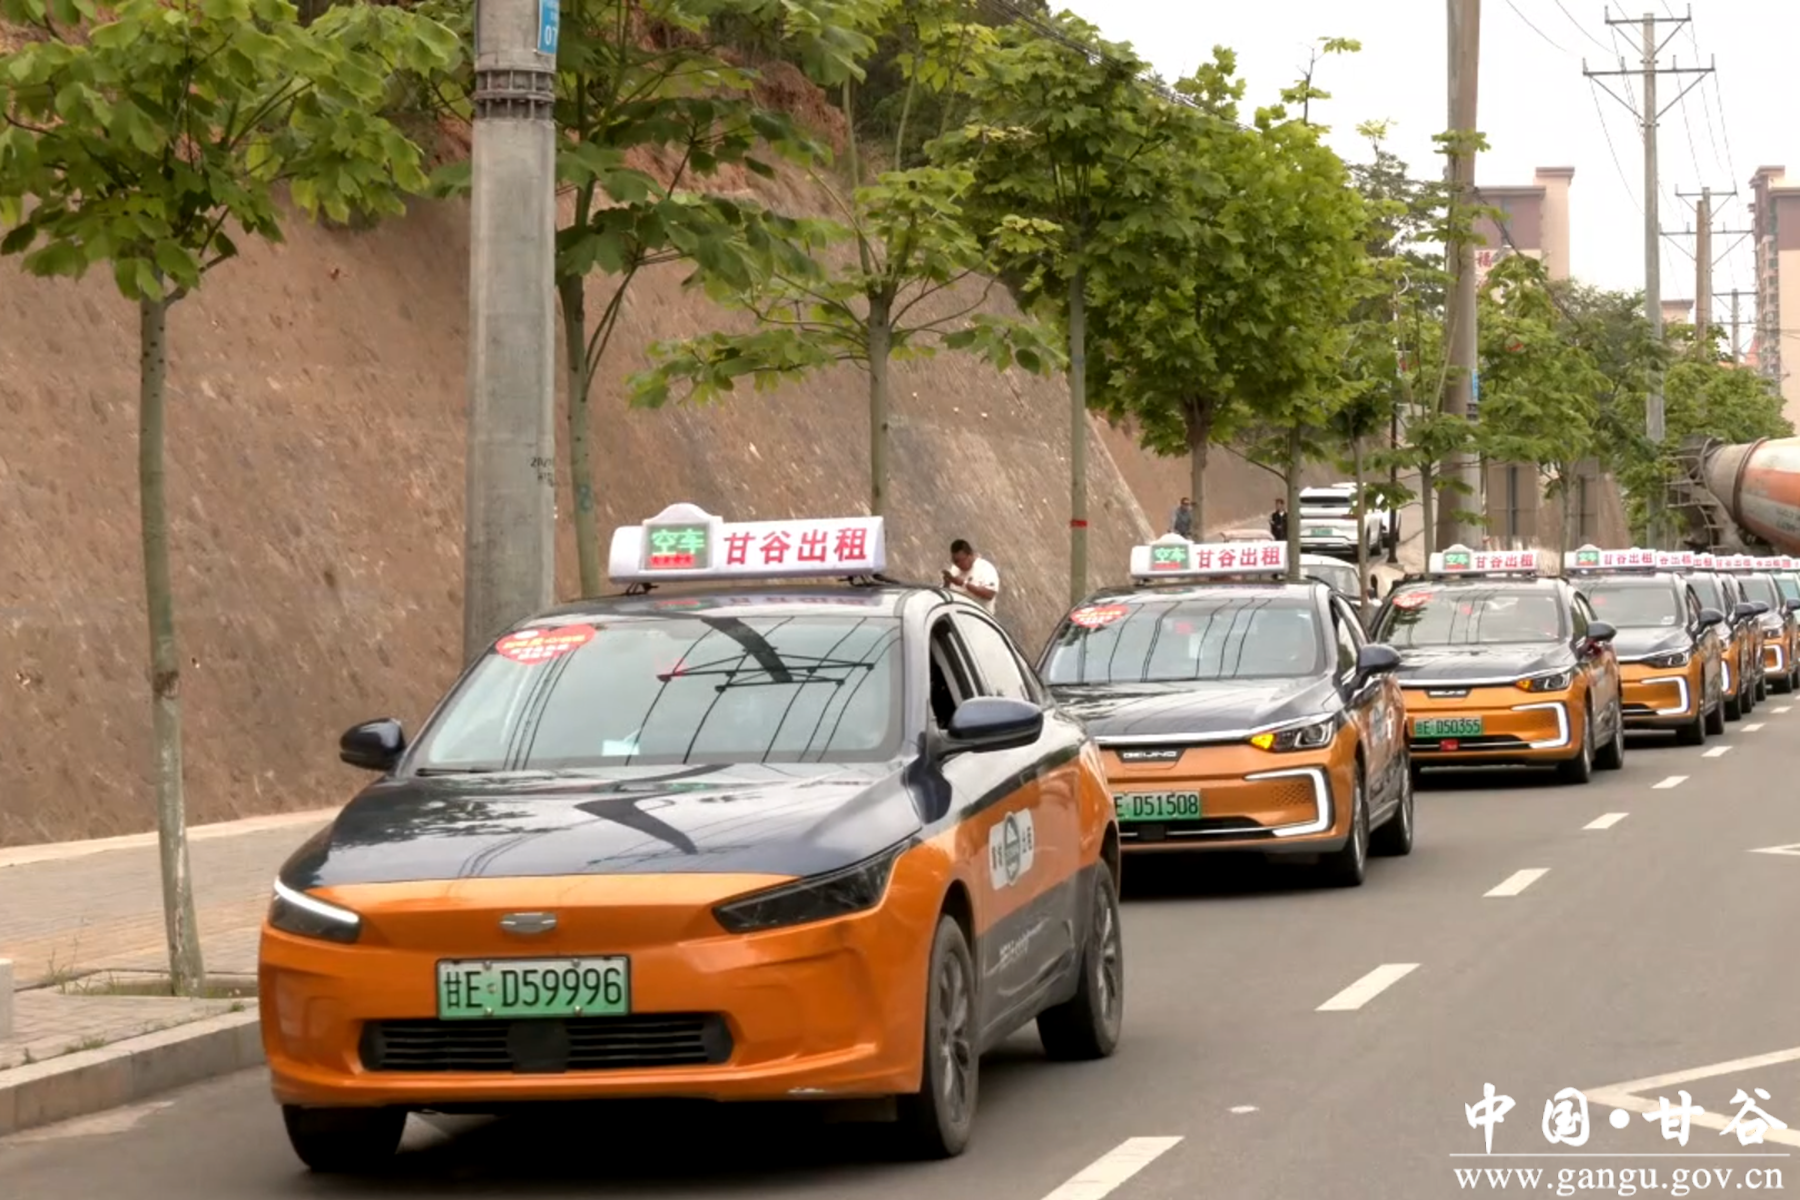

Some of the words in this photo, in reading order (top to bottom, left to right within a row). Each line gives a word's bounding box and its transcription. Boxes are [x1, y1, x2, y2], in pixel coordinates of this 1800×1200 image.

[652, 528, 704, 555] 空车
[724, 528, 868, 564] 甘谷出租
[1196, 546, 1281, 568] 甘谷出租
[1474, 553, 1534, 569] 甘谷出租
[1133, 794, 1199, 817] D51508
